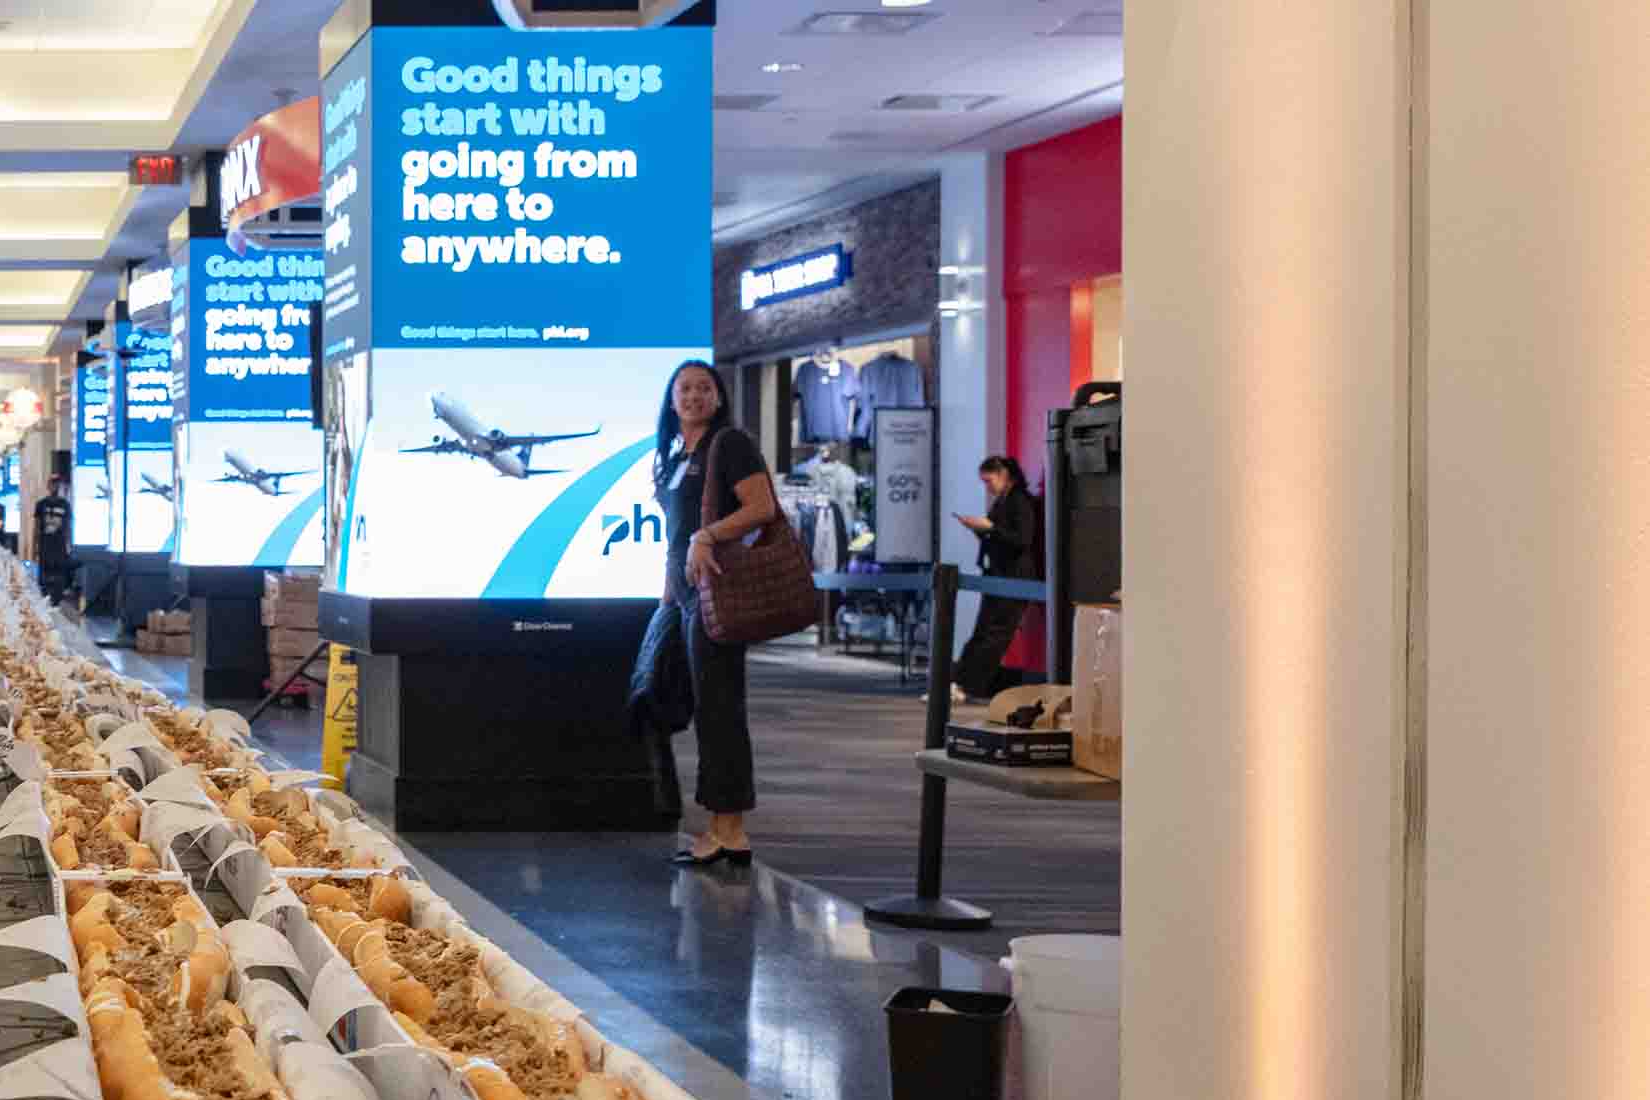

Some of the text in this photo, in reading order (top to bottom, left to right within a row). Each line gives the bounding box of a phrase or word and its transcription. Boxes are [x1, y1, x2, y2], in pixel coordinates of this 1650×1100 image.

[401, 56, 663, 101] Good things
[401, 102, 502, 136] start
[510, 99, 606, 136] with
[137, 156, 175, 184] EXIT
[401, 141, 525, 187] going
[534, 141, 638, 178] from
[402, 185, 554, 221] here to
[401, 227, 621, 272] anywhere.
[205, 254, 325, 278] Good thin
[205, 279, 324, 302] start with
[205, 304, 277, 330] going
[205, 328, 294, 351] here to
[205, 353, 311, 380] anywher
